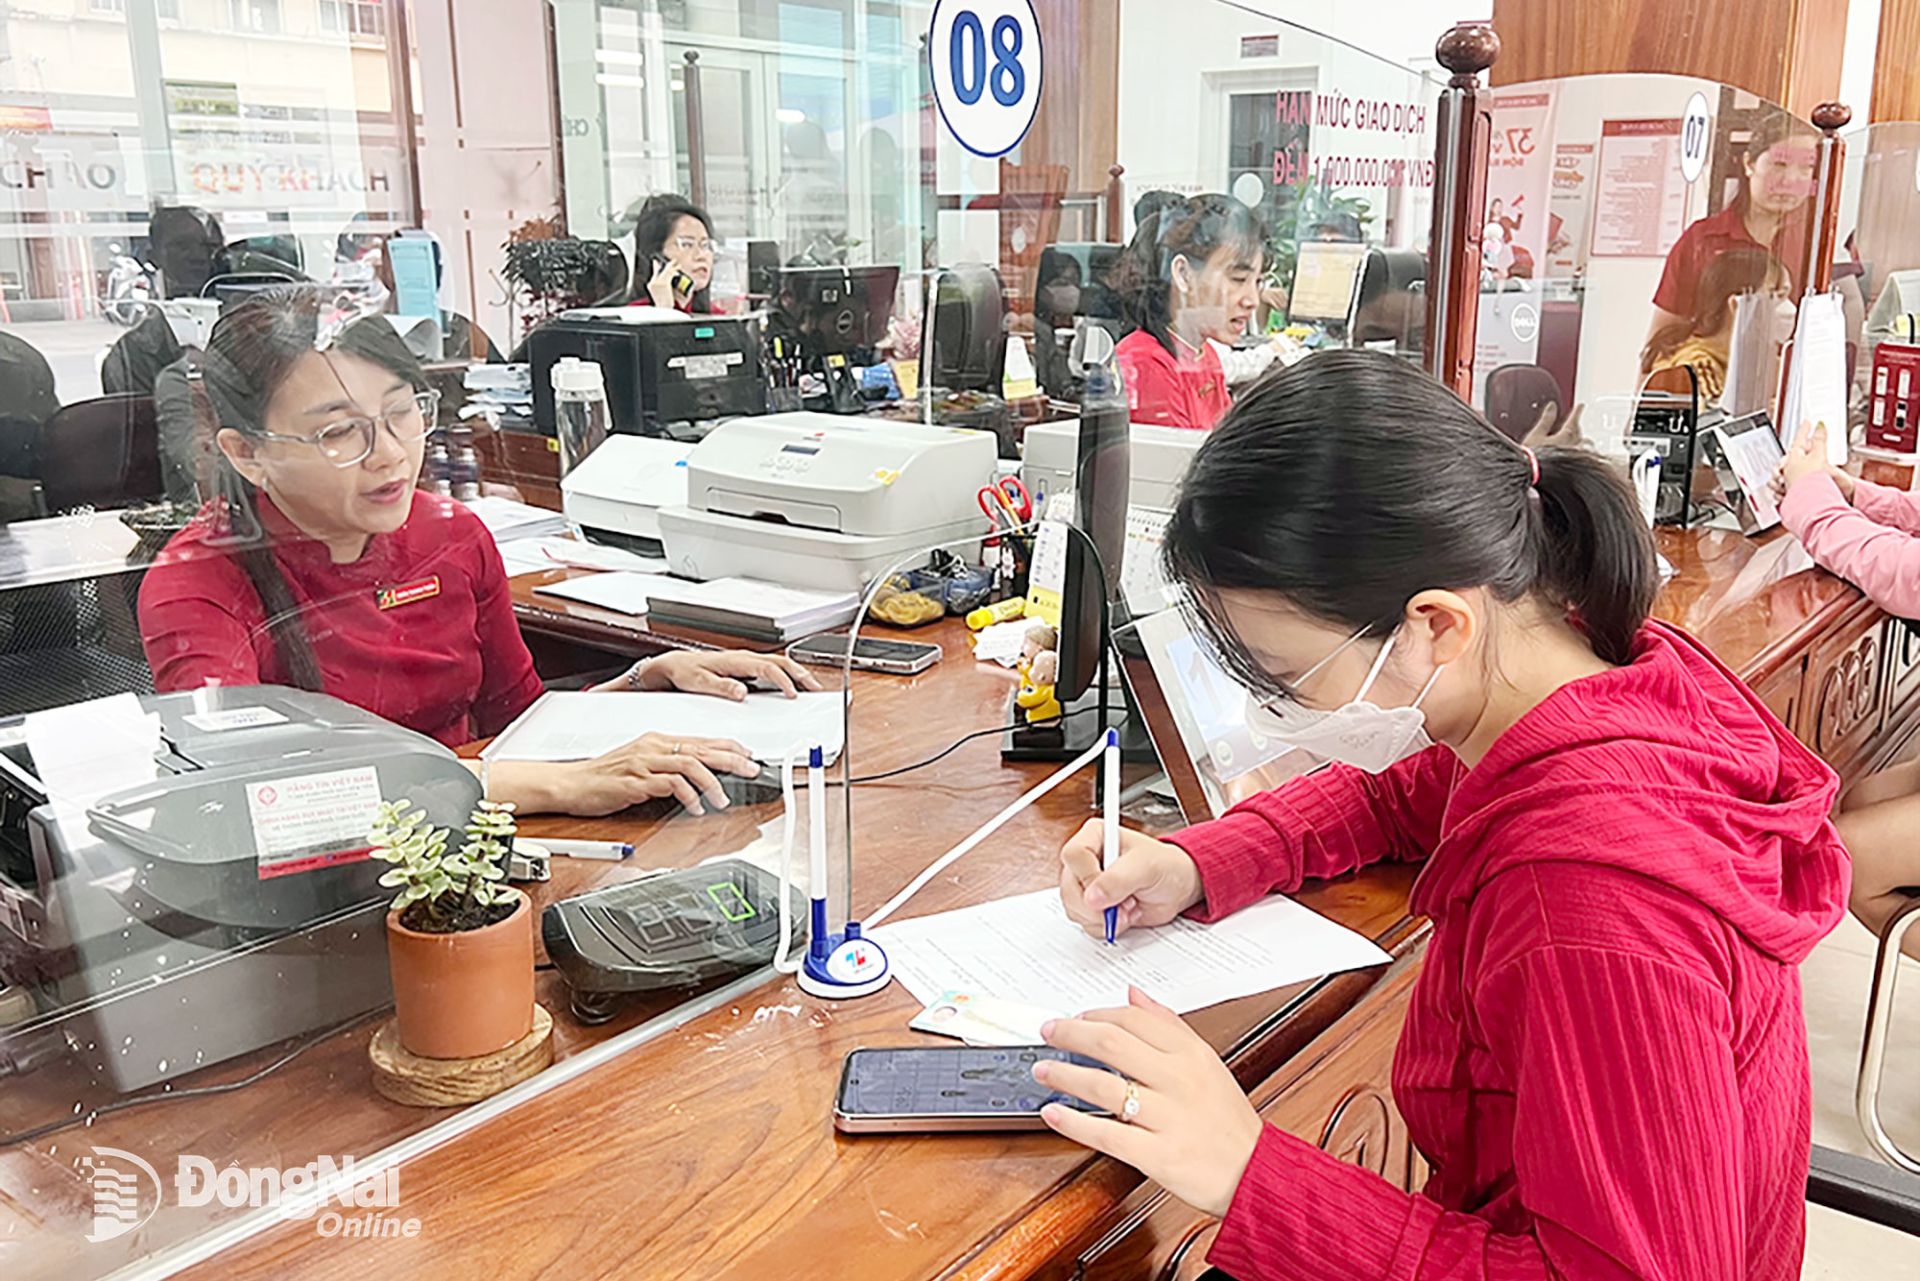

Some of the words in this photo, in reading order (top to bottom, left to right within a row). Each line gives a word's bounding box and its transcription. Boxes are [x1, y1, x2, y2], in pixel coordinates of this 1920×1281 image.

[950, 10, 1025, 107] 08
[1315, 88, 1351, 128] MỨC
[1355, 99, 1391, 132] GIAO
[1393, 103, 1426, 139] DỊCH
[1686, 114, 1706, 159] 07
[1408, 159, 1436, 187] VNĐ
